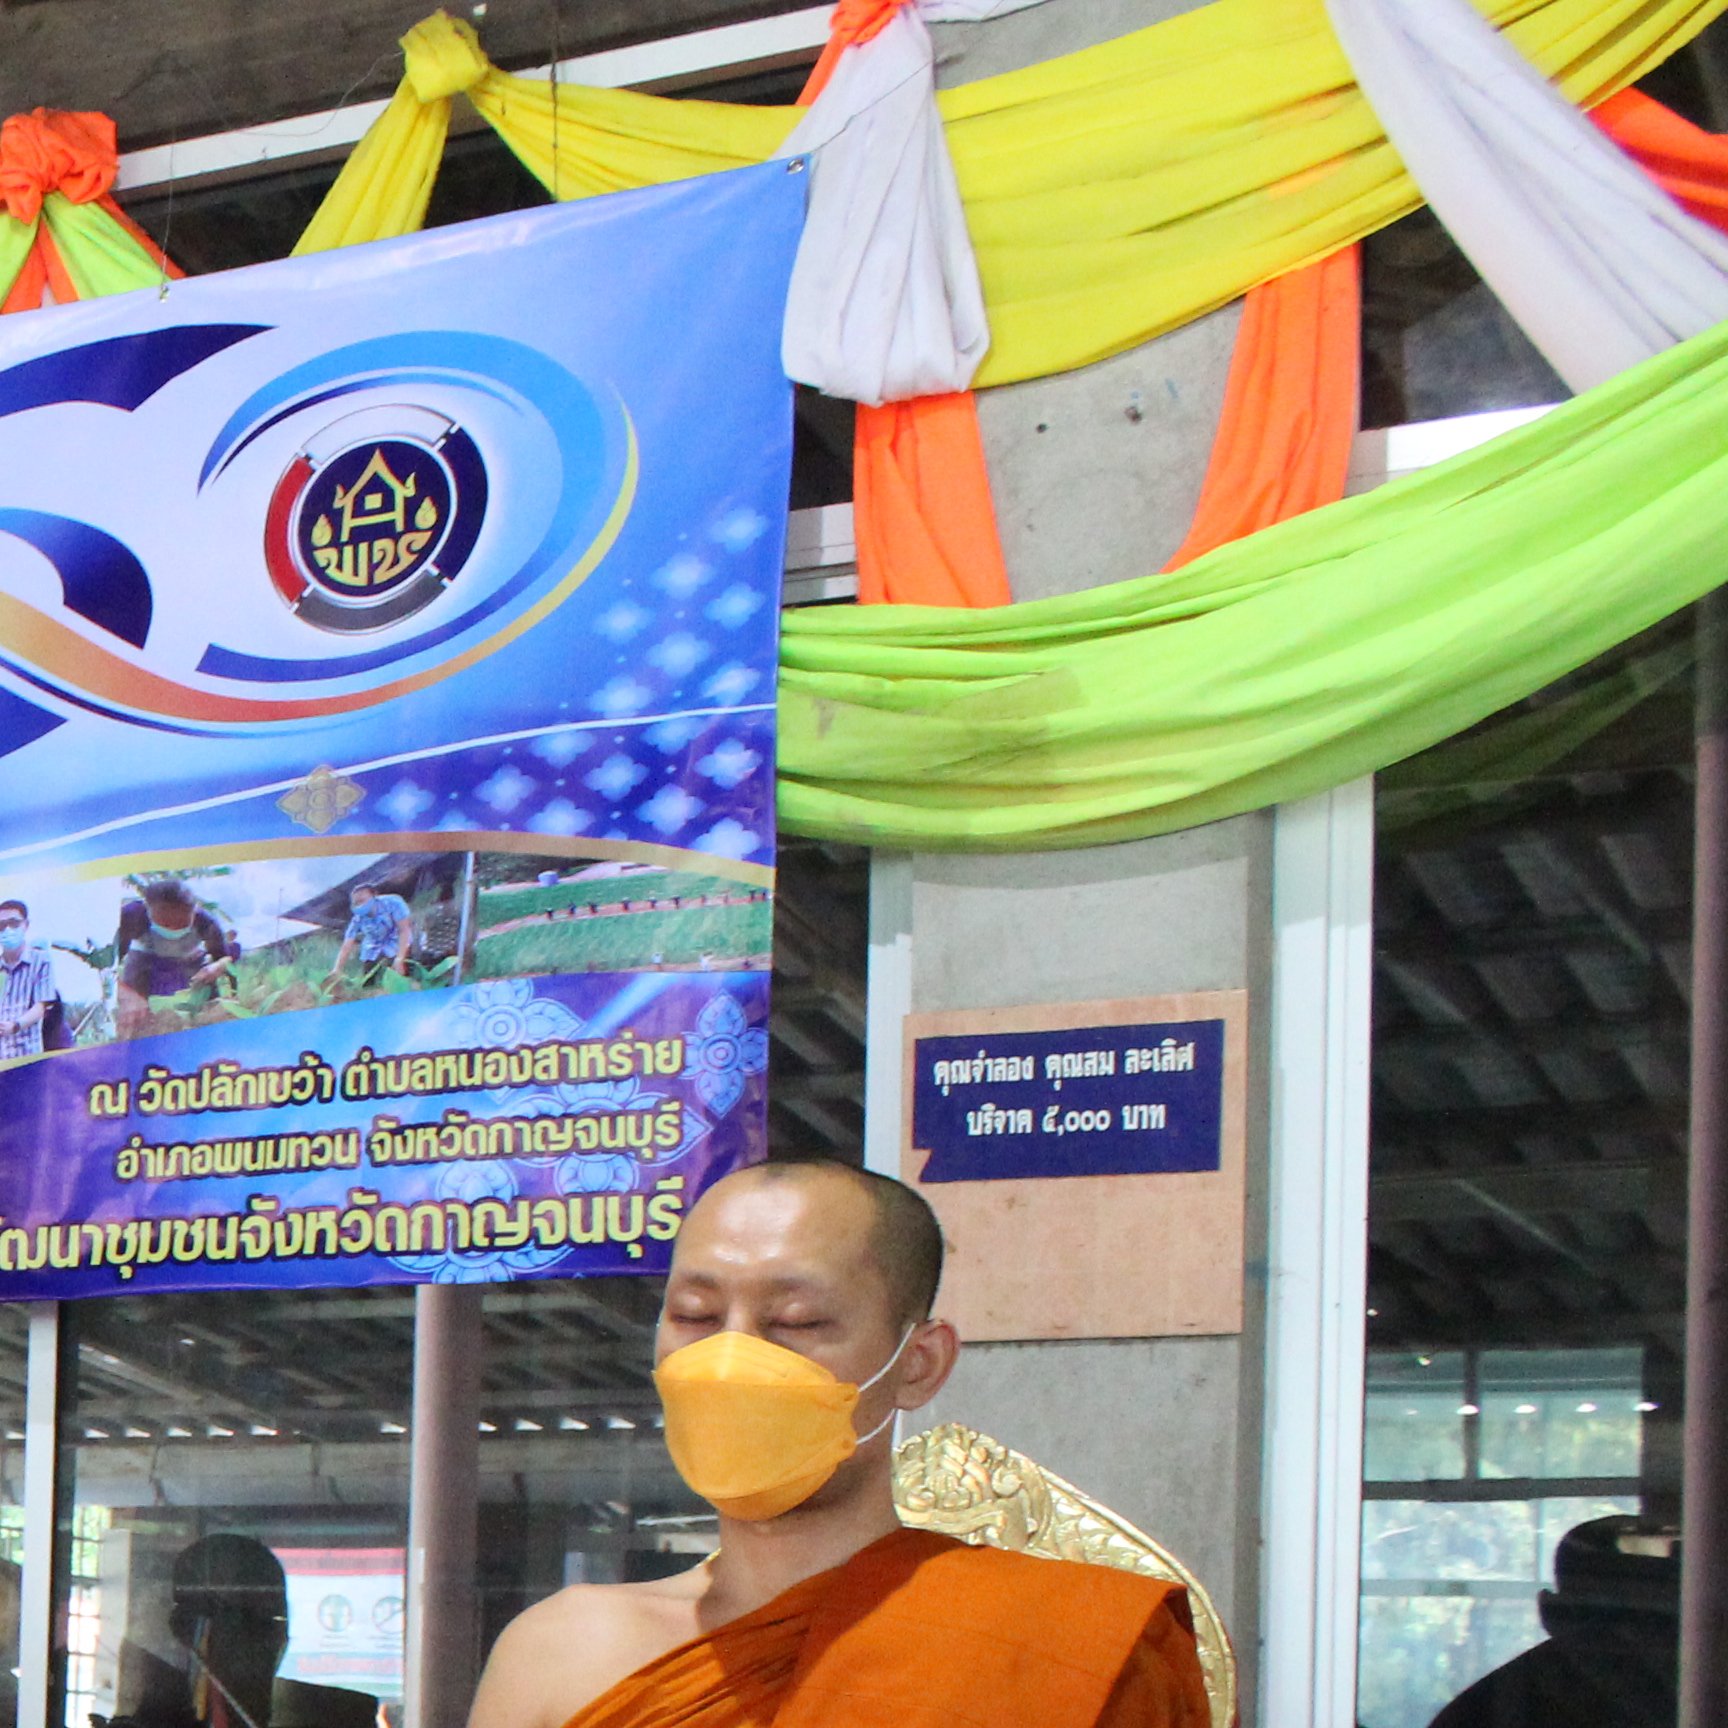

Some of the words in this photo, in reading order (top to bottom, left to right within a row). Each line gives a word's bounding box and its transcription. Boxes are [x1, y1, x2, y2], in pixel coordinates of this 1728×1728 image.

[89, 1081, 128, 1116] ณ
[137, 1054, 334, 1113] วัดปลักเขว้า
[344, 1031, 683, 1097] ตำบลหนองสาหร่าย
[933, 1049, 1035, 1097] คุณจำลอง
[1044, 1050, 1116, 1091] คุณสม
[1124, 1037, 1196, 1074] ละเลิศ
[116, 1130, 360, 1179] อำเภอพนมทวน
[370, 1100, 683, 1163] จังหวัดกาญจนบุรี
[966, 1102, 1033, 1136] บริจาค
[1121, 1103, 1167, 1131] บาท
